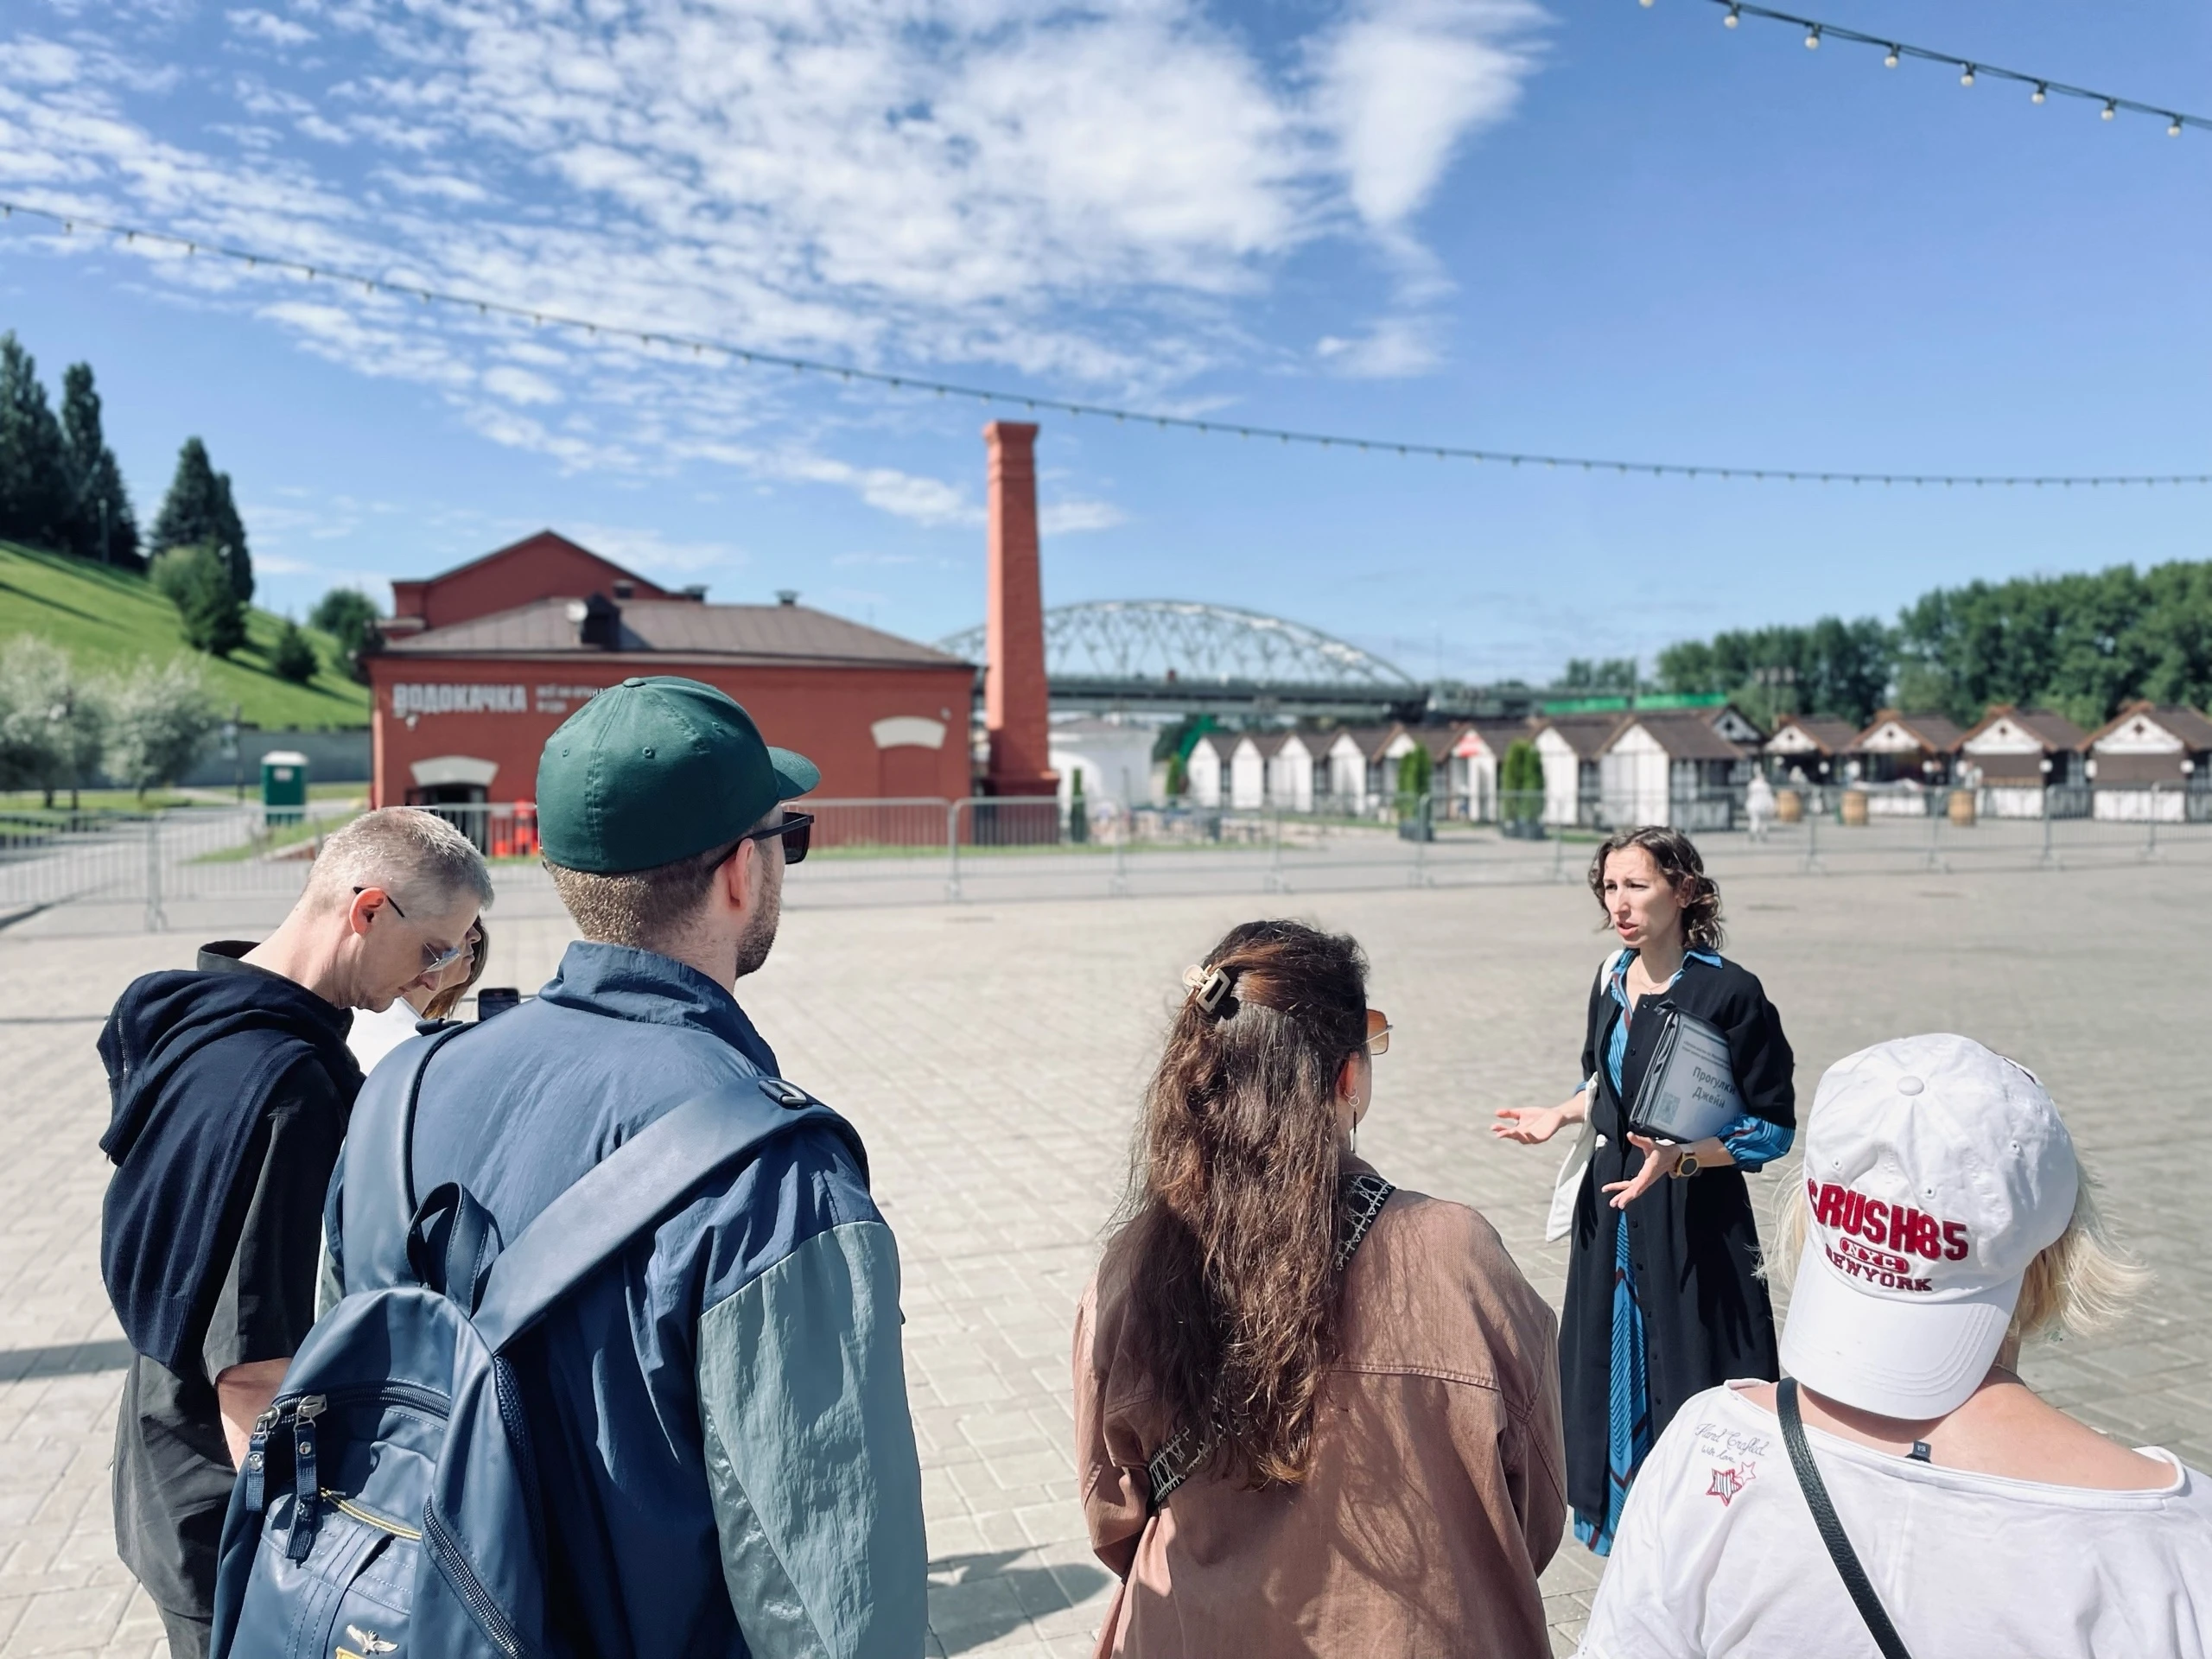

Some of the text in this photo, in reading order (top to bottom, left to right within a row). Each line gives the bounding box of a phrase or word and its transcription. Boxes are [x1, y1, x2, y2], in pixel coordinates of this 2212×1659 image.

[392, 683, 528, 715] ВОДОКАЧКА
[1693, 1066, 1736, 1095] Прогулки
[1692, 1086, 1726, 1109] Джейн
[1695, 1423, 1727, 1442] Hand
